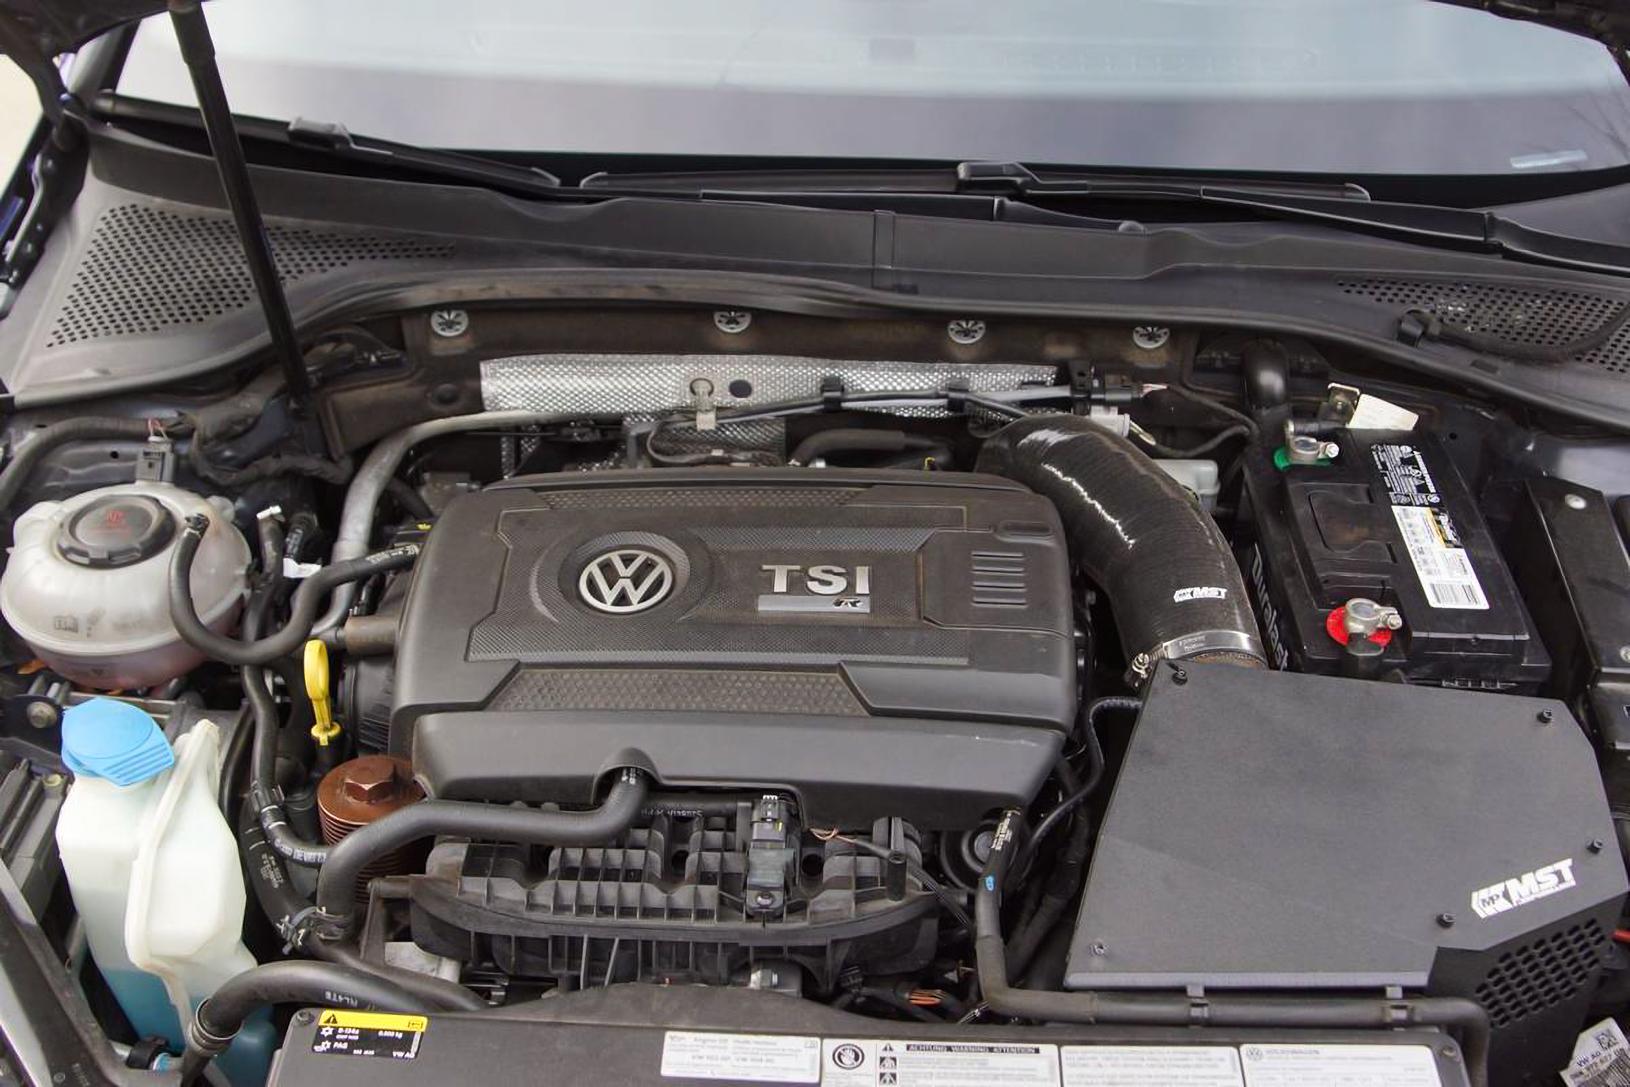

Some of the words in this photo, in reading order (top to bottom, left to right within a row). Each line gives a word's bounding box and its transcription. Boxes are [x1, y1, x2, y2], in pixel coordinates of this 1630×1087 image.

[762, 565, 870, 595] TSI
[1192, 587, 1228, 599] MST
[1252, 542, 1289, 671] Duralast
[1505, 858, 1577, 906] MST
[951, 1045, 988, 1053] WARNING
[993, 1046, 1034, 1054] ATTENTION
